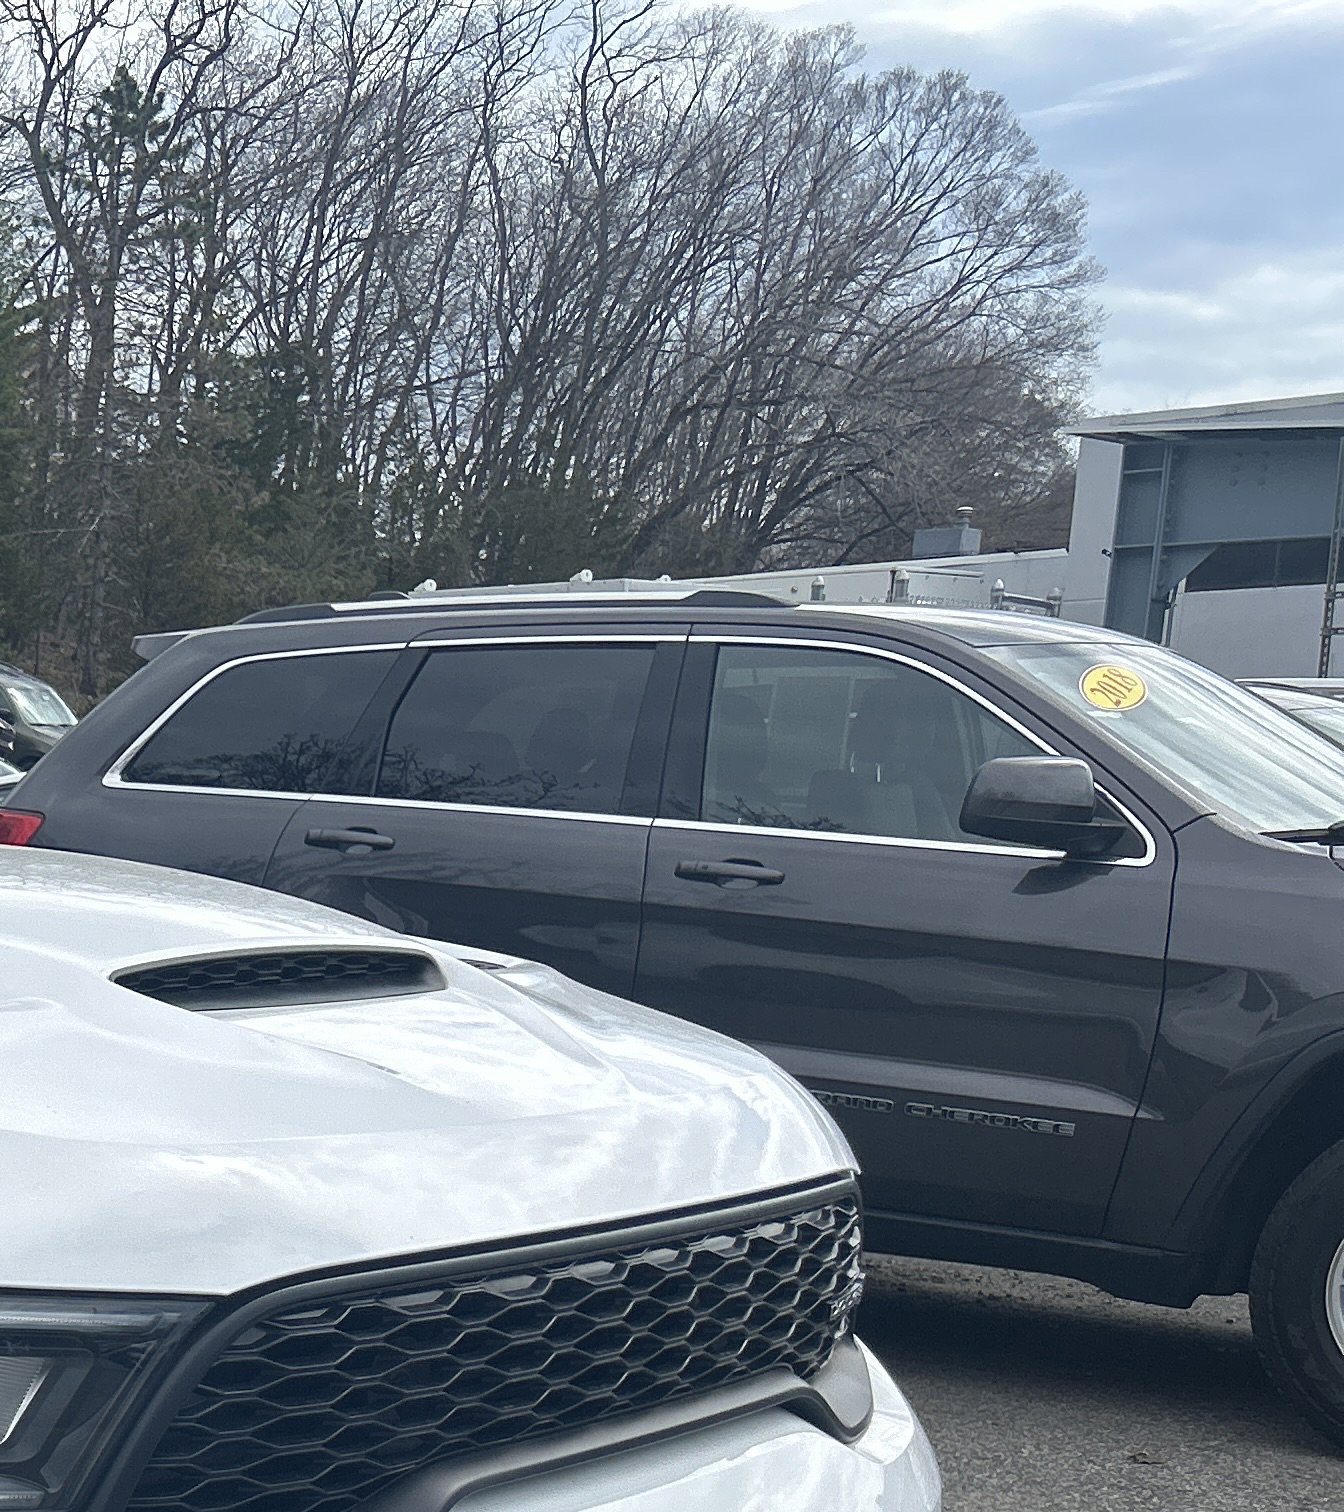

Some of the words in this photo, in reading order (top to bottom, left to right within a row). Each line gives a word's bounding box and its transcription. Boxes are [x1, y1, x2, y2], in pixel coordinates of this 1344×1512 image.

[1090, 668, 1138, 708] 2018
[808, 1089, 895, 1114] RAND
[904, 1102, 1076, 1138] CHEROKEE
